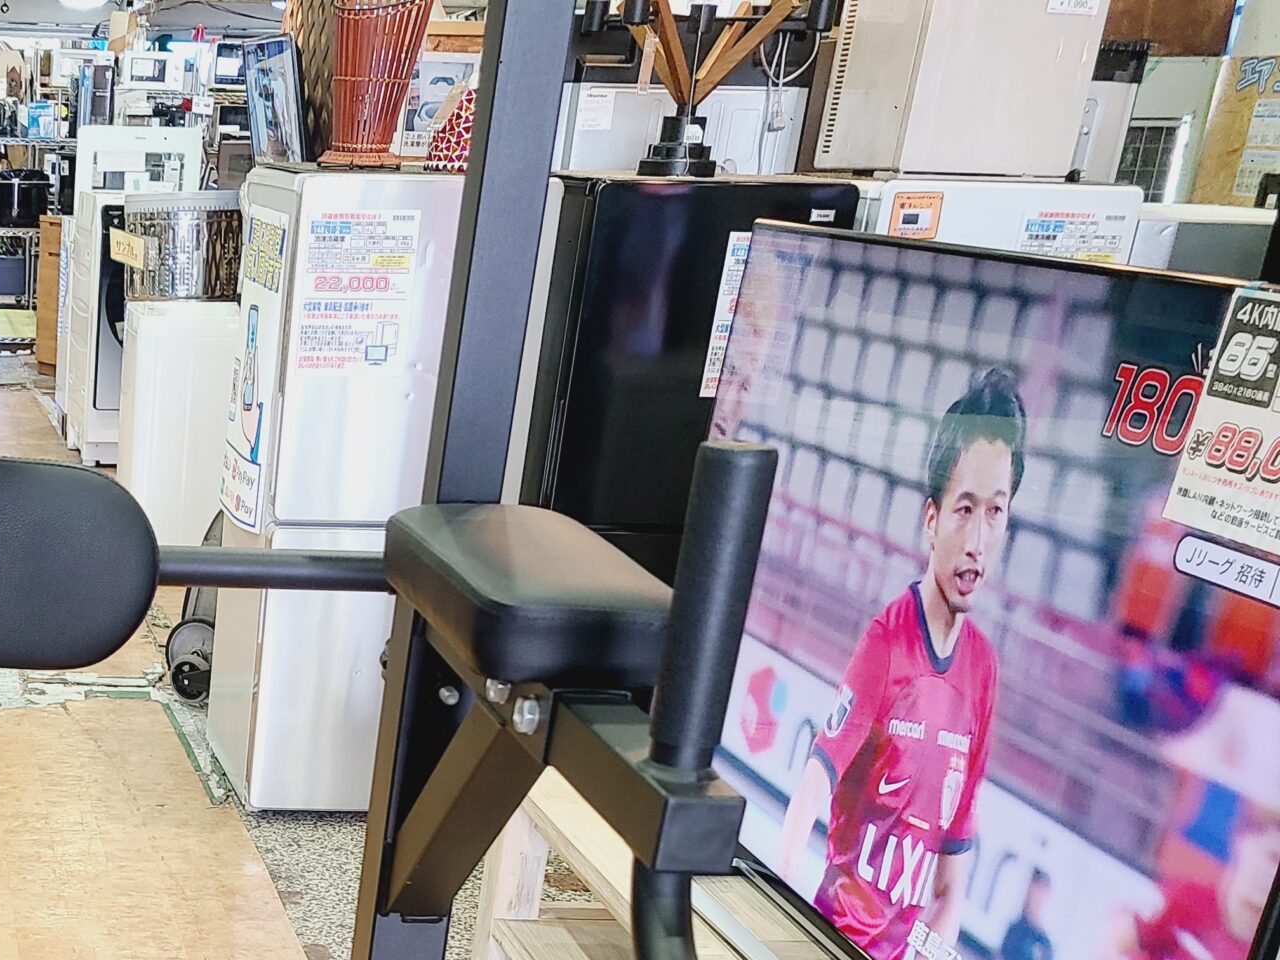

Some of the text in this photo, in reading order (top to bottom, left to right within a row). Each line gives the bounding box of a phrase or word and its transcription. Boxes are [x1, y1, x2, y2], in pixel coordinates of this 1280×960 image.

[1236, 58, 1280, 94] エア
[314, 276, 389, 293] 22,000
[1236, 302, 1280, 330] 4K内
[1102, 363, 1205, 456] 180
[1186, 547, 1266, 588] Jリーグ 招待
[889, 717, 926, 740] mercari
